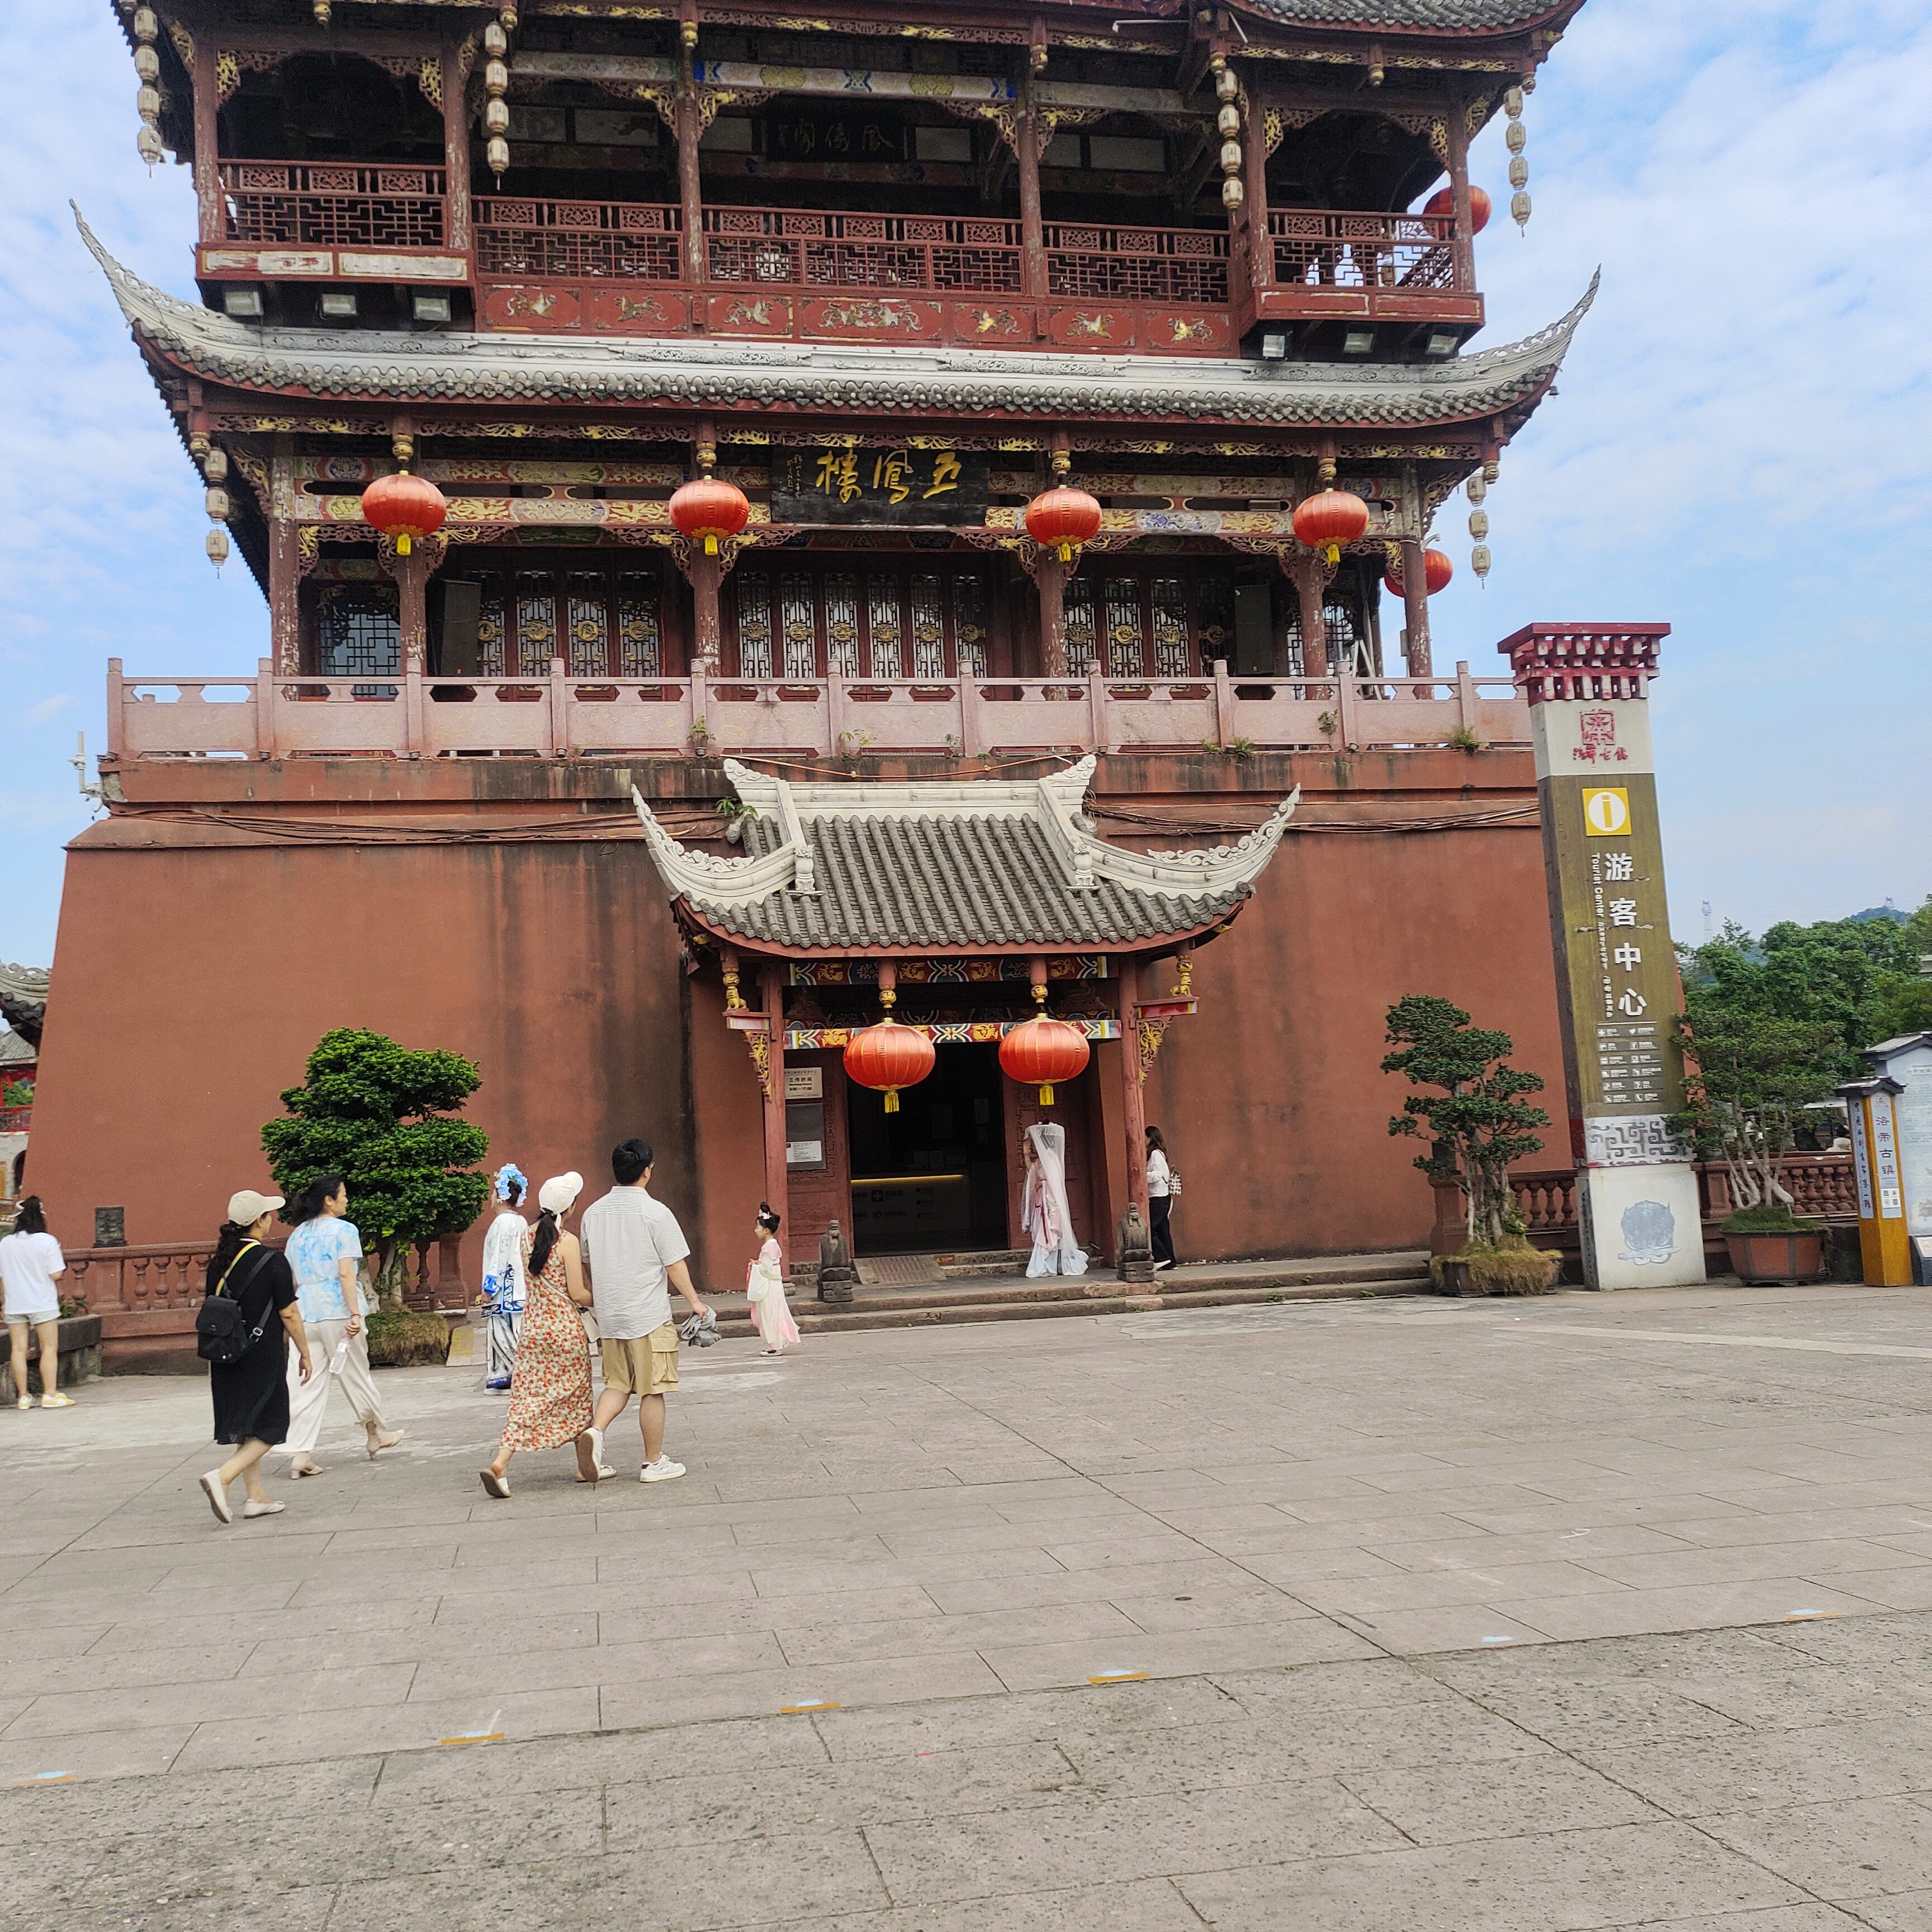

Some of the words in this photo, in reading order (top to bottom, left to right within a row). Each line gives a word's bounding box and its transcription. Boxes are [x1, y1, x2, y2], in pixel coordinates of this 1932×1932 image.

[1591, 853, 1602, 884] Tourist
[1594, 887, 1605, 918] Center
[1605, 853, 1647, 1016] 游客中心
